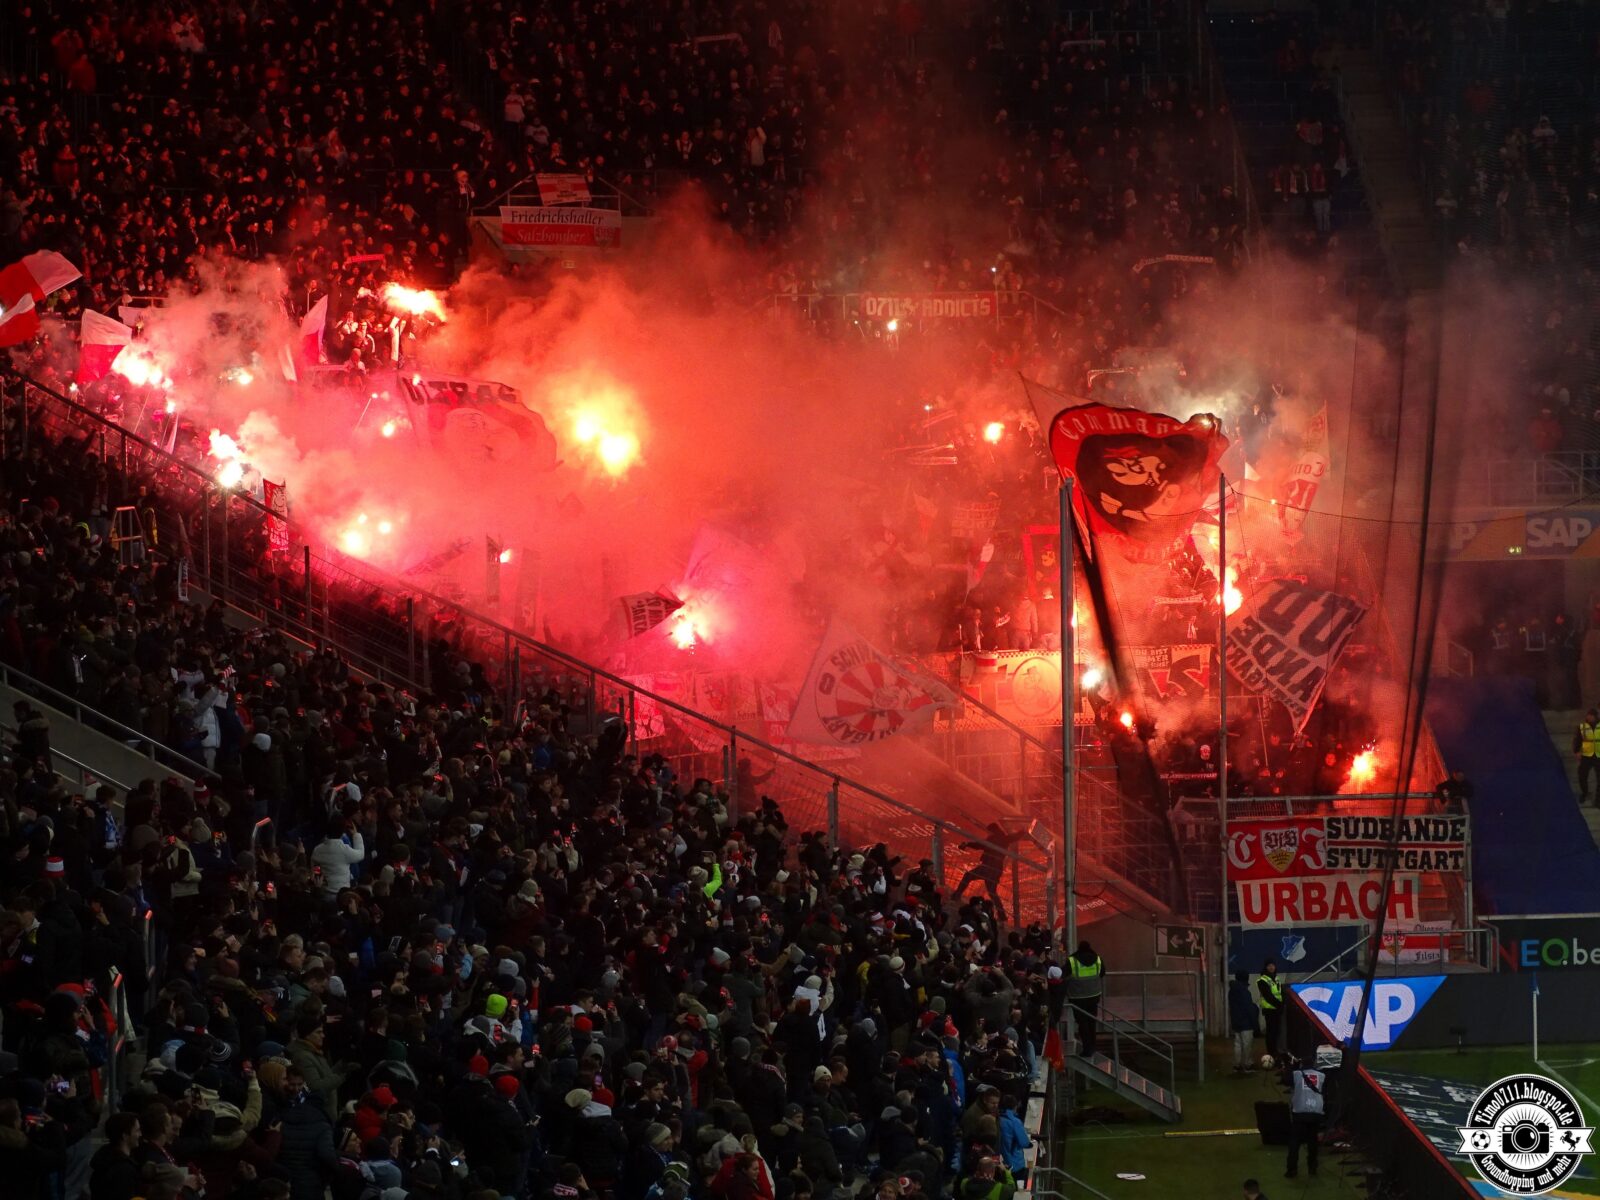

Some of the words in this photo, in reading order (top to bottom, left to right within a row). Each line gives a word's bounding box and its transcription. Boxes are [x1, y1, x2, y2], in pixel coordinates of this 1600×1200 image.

[511, 208, 604, 225] Friedrichshaller
[922, 298, 991, 318] ADDICTS
[1058, 411, 1196, 441] Comman
[1526, 517, 1592, 548] SAP
[1326, 815, 1467, 843] SÜDBANDE
[1326, 847, 1464, 871] STUTTGART
[1241, 879, 1415, 924] URBACH
[1297, 983, 1416, 1045] SAP
